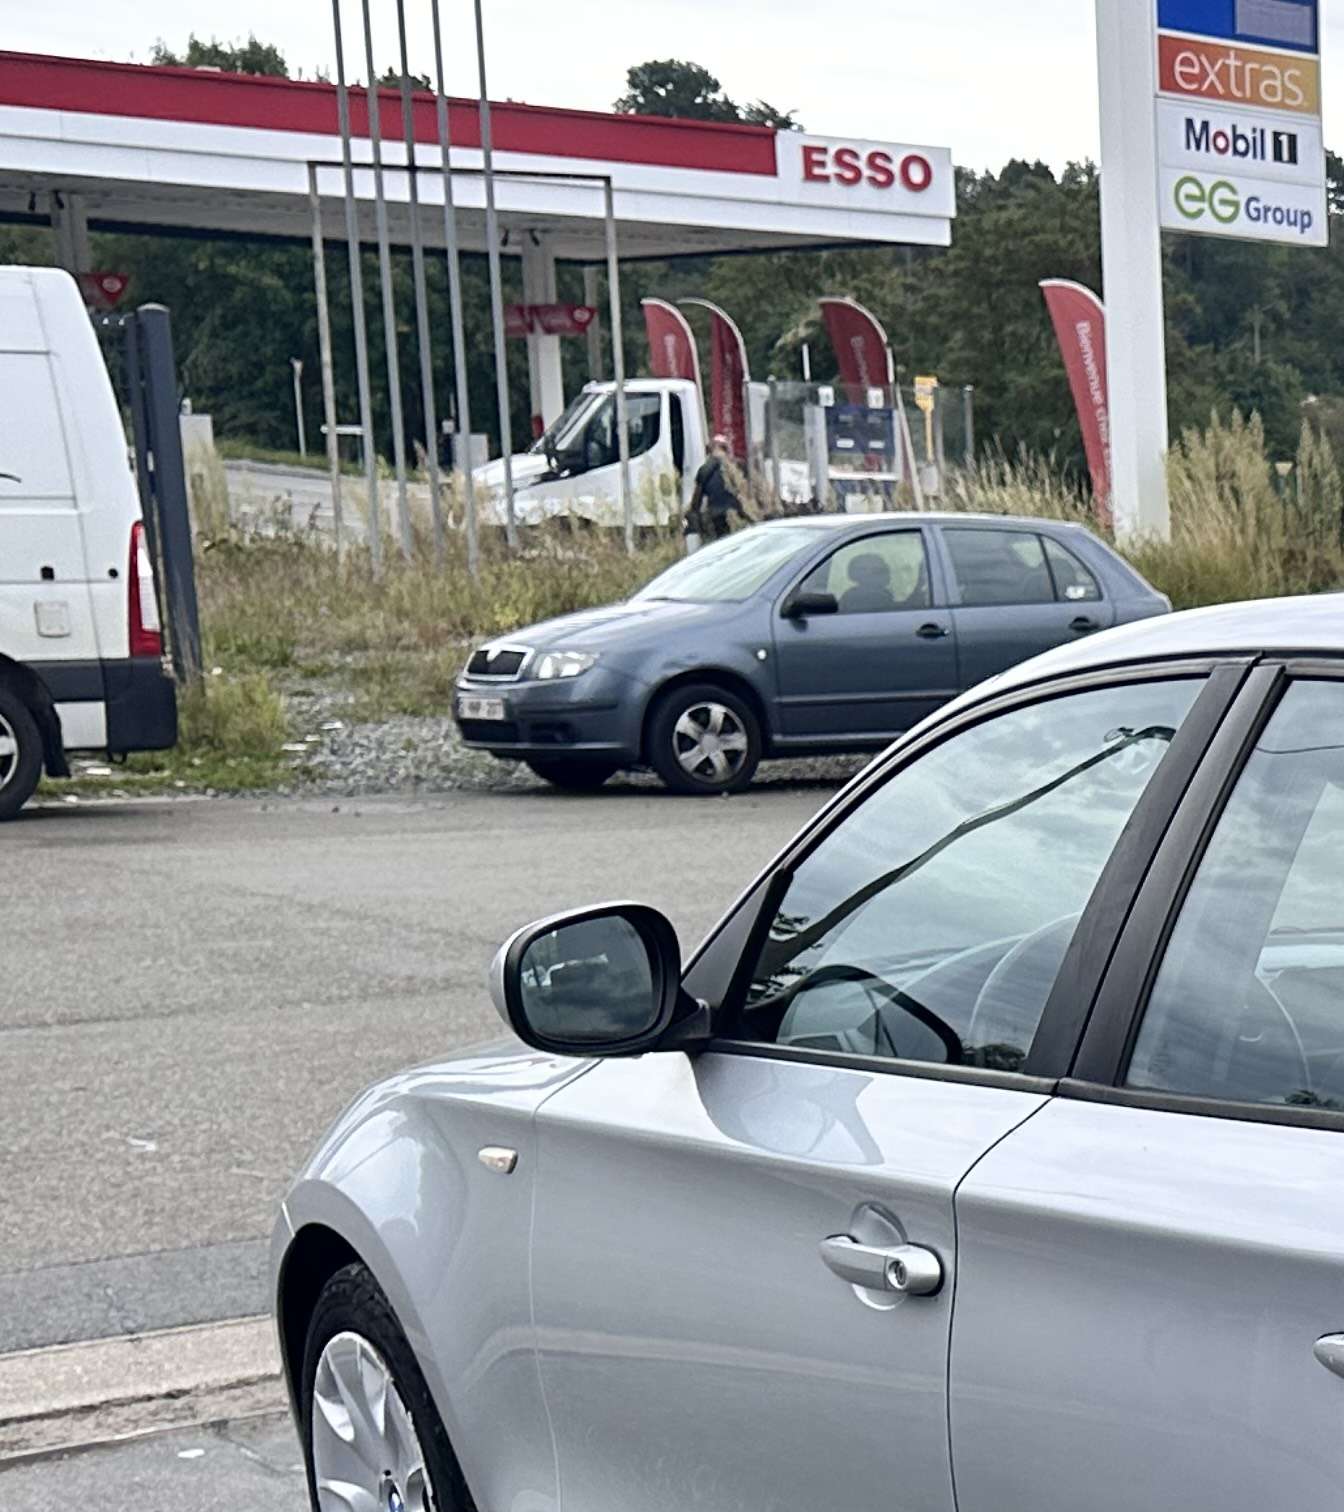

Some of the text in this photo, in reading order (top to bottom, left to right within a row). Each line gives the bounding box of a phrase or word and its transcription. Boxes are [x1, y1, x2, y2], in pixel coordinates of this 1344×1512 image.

[1174, 50, 1304, 106] extras
[1185, 117, 1294, 163] Mobil 1
[801, 144, 933, 192] ESSO
[1245, 196, 1312, 233] Group
